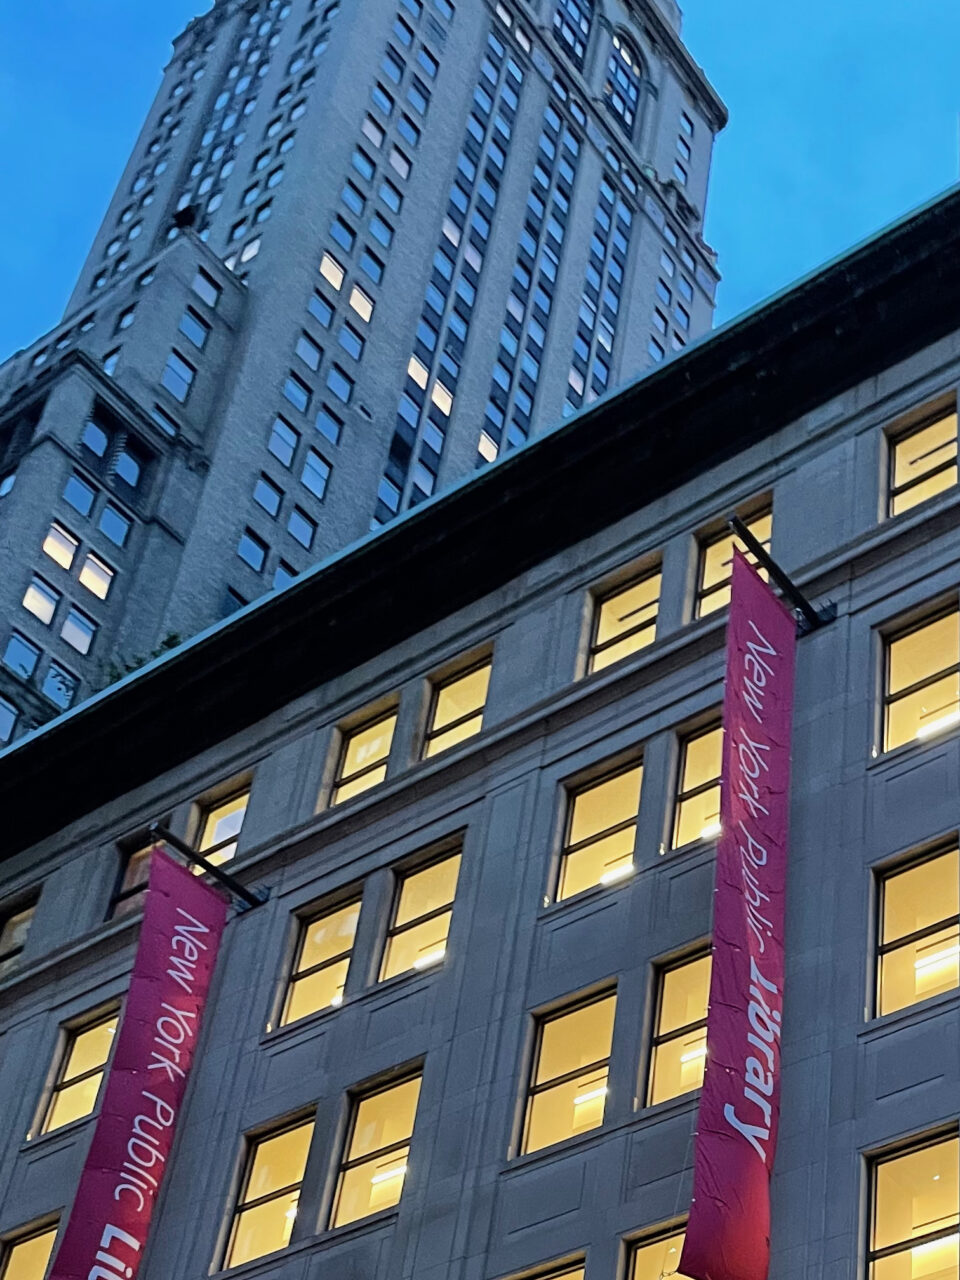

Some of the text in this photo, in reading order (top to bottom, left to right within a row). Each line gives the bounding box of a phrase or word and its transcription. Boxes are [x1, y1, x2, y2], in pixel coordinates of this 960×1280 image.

[744, 620, 777, 724] New
[739, 727, 770, 816] York
[166, 907, 210, 994] New
[146, 1002, 197, 1082] York
[725, 956, 782, 1164] Library
[114, 1090, 176, 1212] Public
